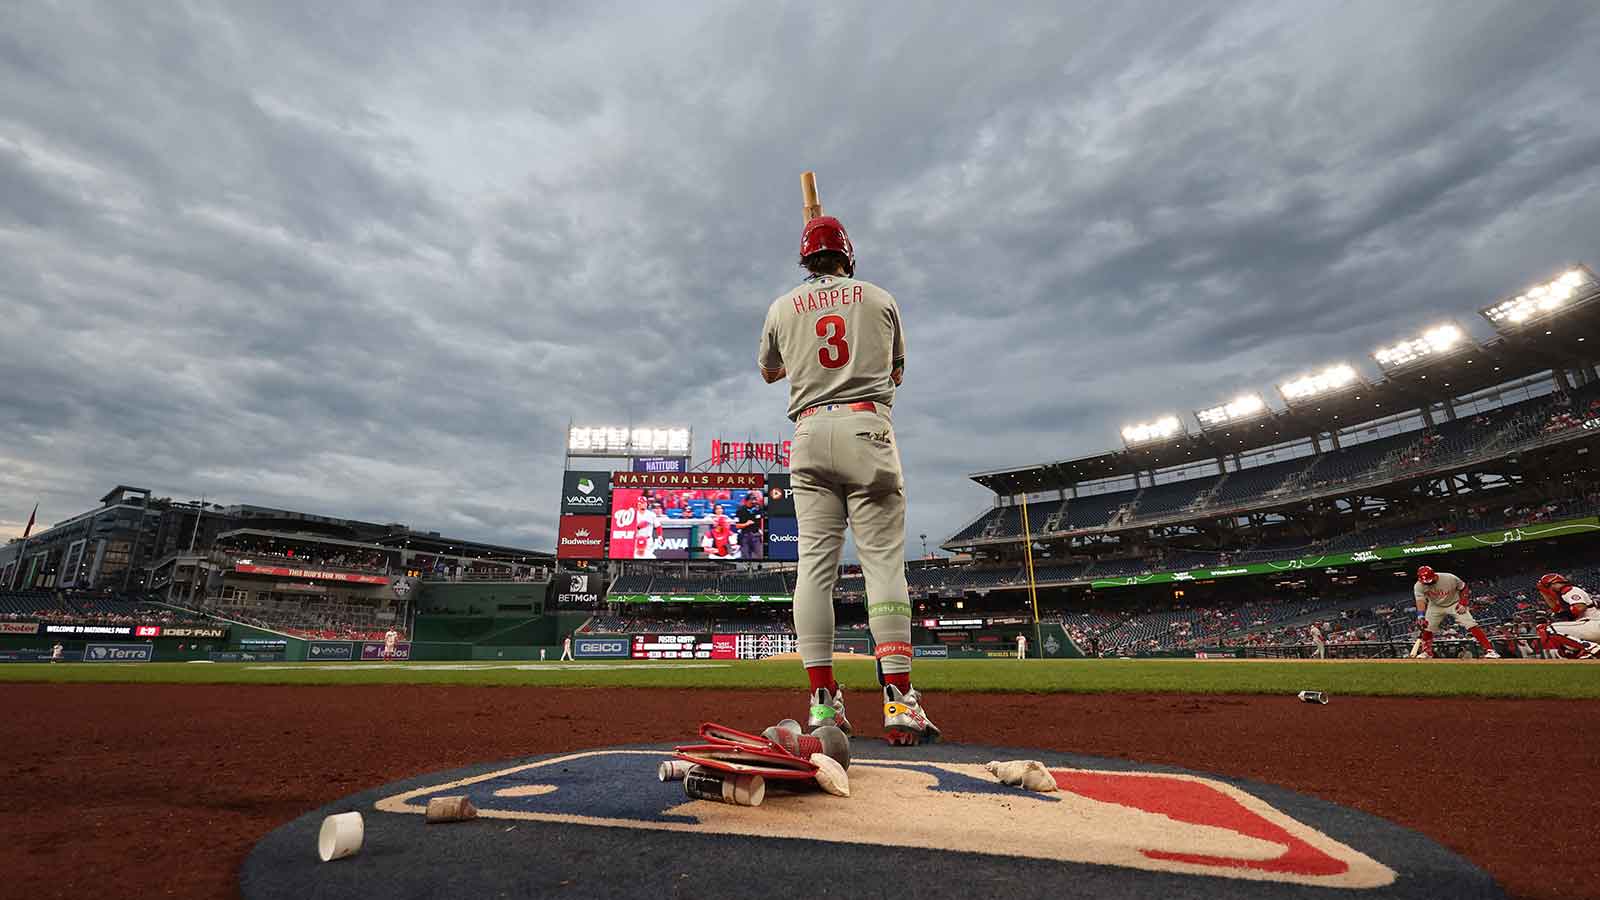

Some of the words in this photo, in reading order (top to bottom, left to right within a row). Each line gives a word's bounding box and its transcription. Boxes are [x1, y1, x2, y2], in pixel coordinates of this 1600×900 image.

[793, 285, 863, 315] HARPER
[815, 314, 850, 369] 3
[711, 440, 792, 467] NATIONALS
[646, 460, 679, 471] NATITUDE
[619, 475, 709, 484] NATIONALS
[717, 475, 756, 484] PARK
[558, 594, 597, 602] BETMGM
[47, 625, 75, 633] WELCOME
[76, 625, 83, 633] TO
[84, 625, 115, 634] NATIONALS
[115, 626, 131, 634] PARK
[194, 628, 223, 638] FAN
[321, 647, 350, 655] VANDA
[580, 643, 622, 652] GEICO
[109, 648, 148, 658] Terra
